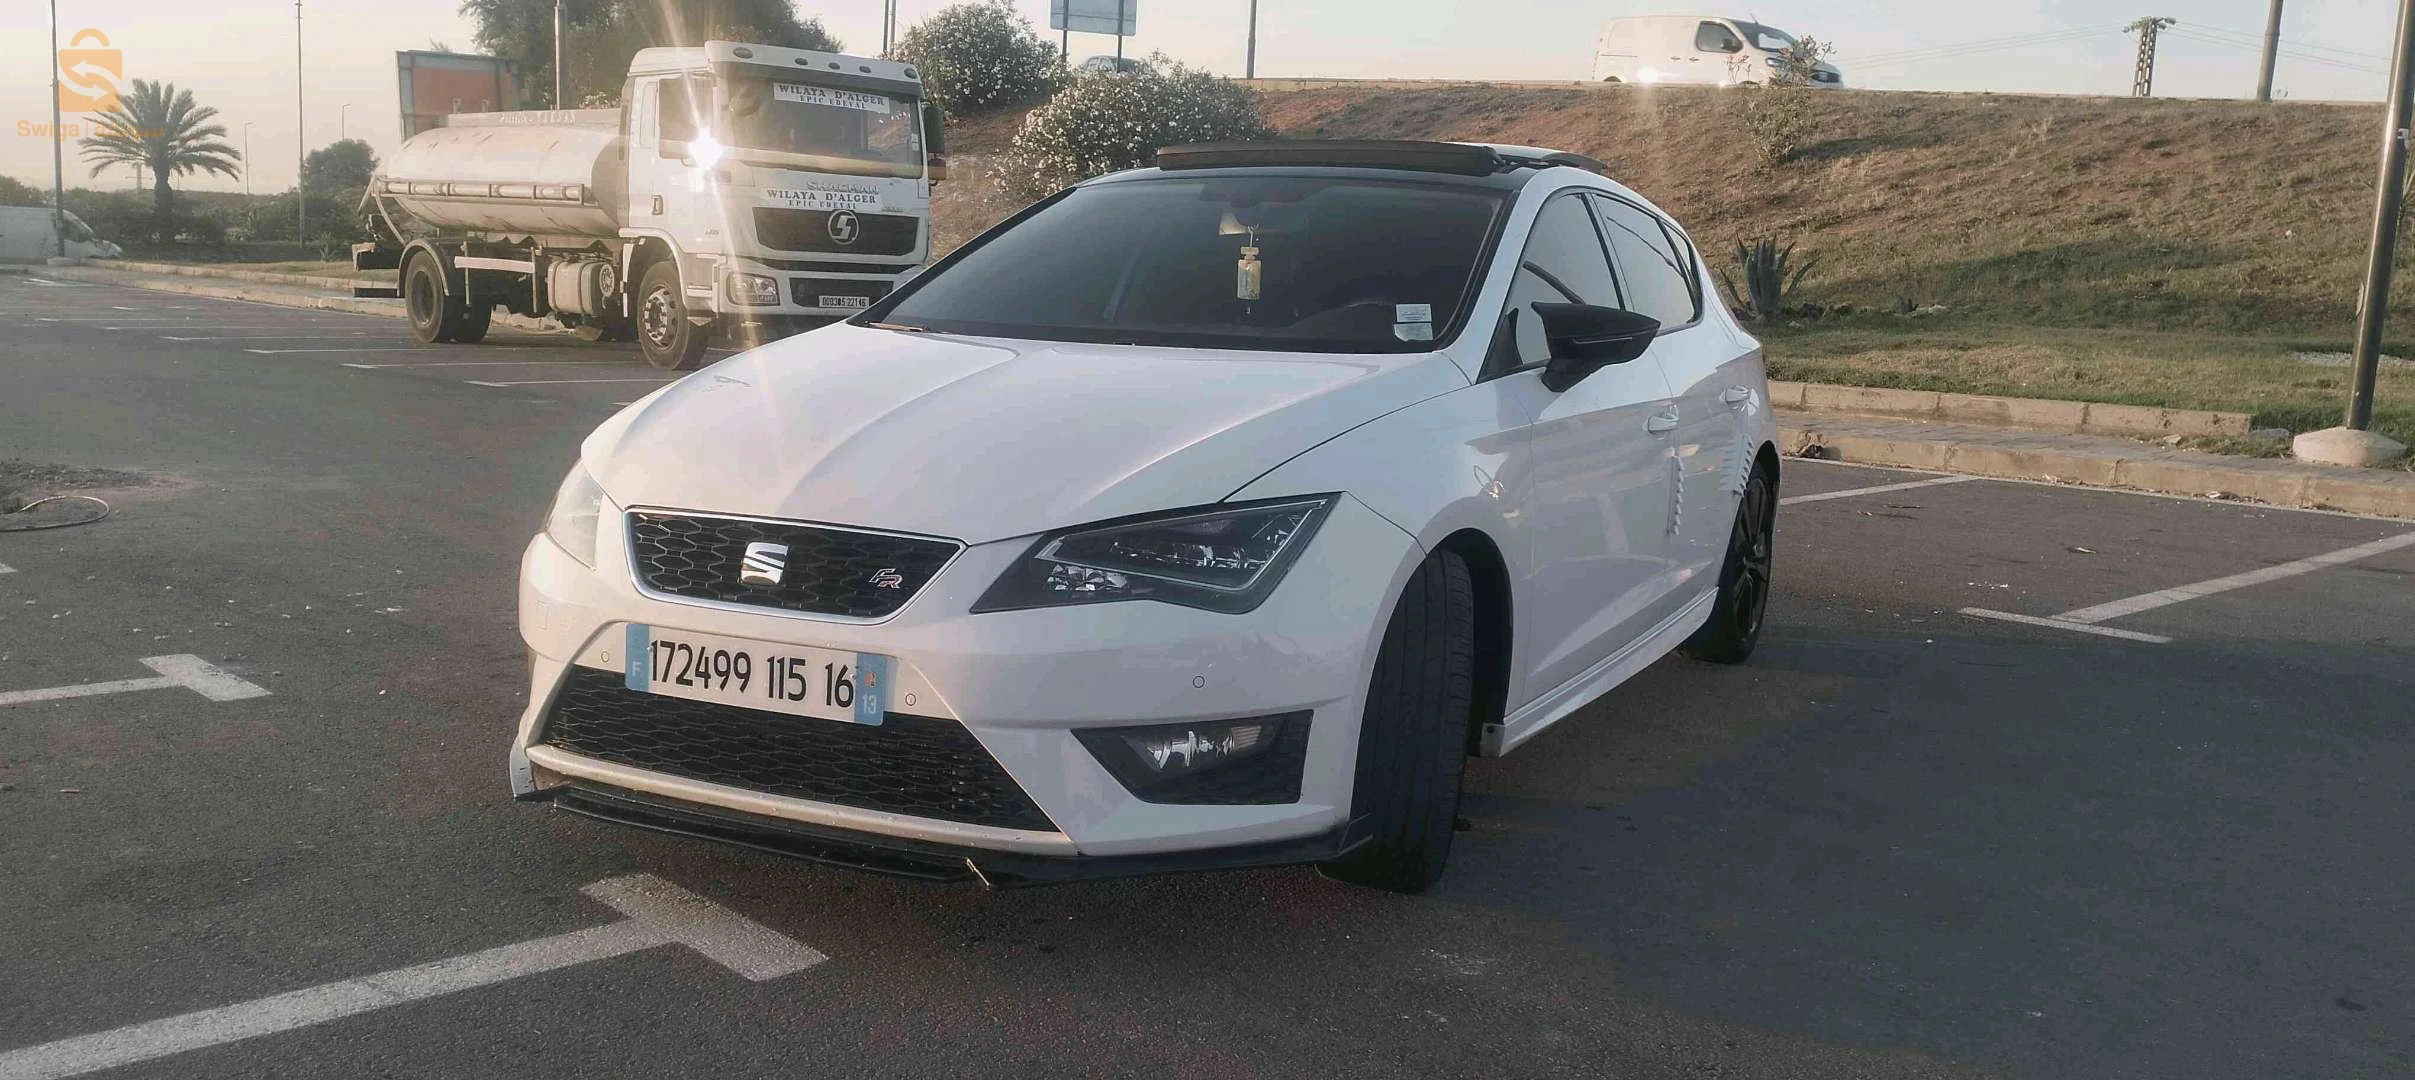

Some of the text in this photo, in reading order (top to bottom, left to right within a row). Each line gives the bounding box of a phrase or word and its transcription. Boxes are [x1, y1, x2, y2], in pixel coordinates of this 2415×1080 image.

[778, 84, 885, 106] WILAYA D'ALGER
[766, 188, 877, 204] WILAYA D'ALGER
[631, 661, 642, 677] F
[650, 639, 855, 708] 172499 115 16
[862, 693, 877, 715] 13
